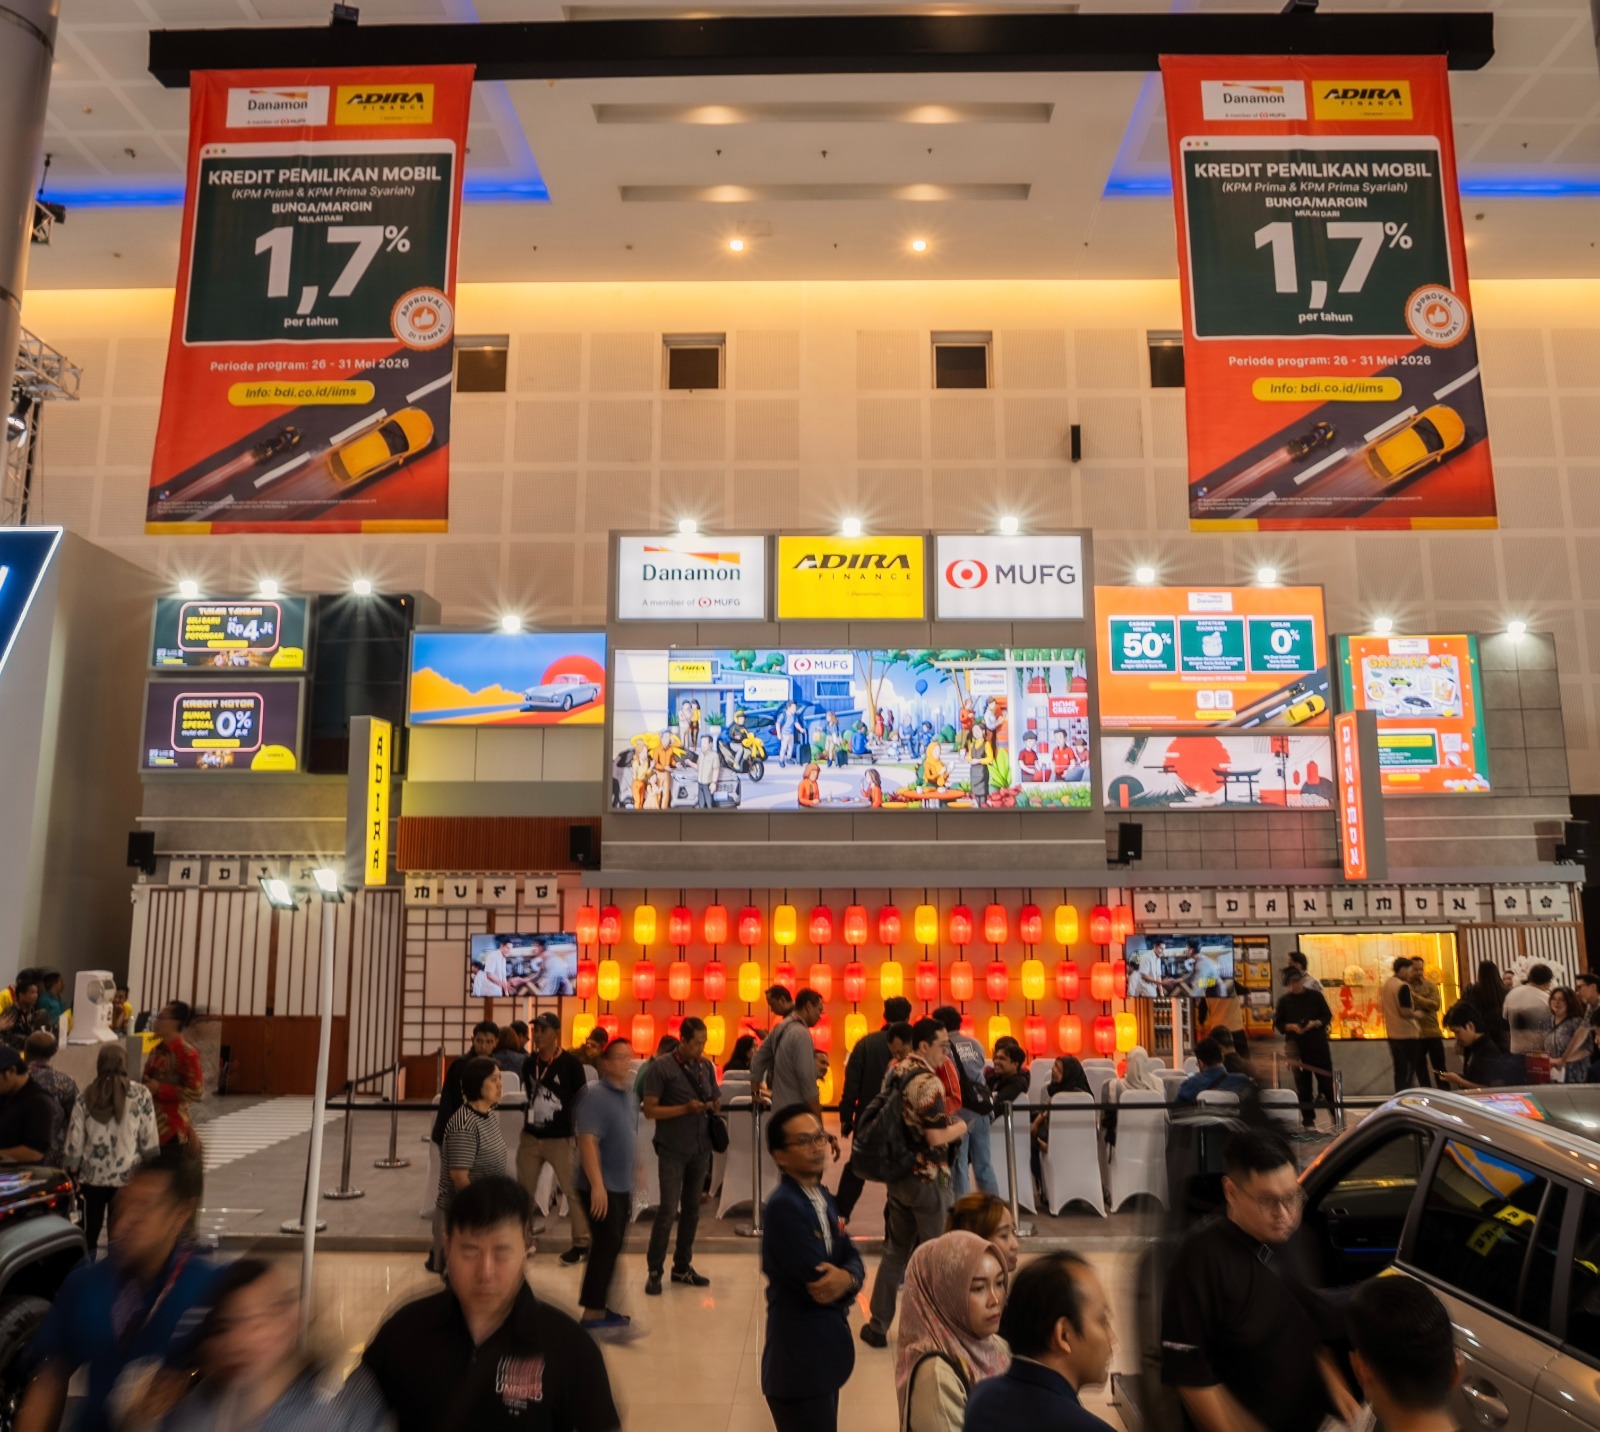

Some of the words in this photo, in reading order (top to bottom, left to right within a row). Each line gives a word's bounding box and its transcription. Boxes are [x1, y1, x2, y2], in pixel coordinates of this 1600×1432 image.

[347, 92, 424, 104] ADIRA
[1223, 92, 1285, 104] Danamon
[1323, 88, 1402, 99] ADIRA
[248, 99, 308, 111] Danamon
[208, 169, 275, 186] KREDIT
[279, 167, 379, 183] PEMILIKAN
[382, 166, 442, 181] MOBIL
[1194, 163, 1262, 178] KREDIT
[1267, 162, 1369, 178] PEMILIKAN
[1372, 162, 1432, 177] MOBIL
[232, 187, 261, 200] (KPM
[263, 187, 294, 198] Prima
[296, 187, 305, 197] &
[307, 187, 333, 197] KPM
[335, 186, 367, 197] Prima
[369, 185, 416, 199] Syariah)
[1222, 181, 1252, 193] (KPM
[1254, 182, 1287, 192] Prima
[1289, 182, 1297, 192] &
[1300, 182, 1325, 192] KPM
[1327, 182, 1360, 192] Prima
[1362, 181, 1408, 194] Syariah)
[272, 201, 372, 214] BUNGA/MARGIN
[1265, 197, 1368, 208] BUNGA/MARGIN
[298, 215, 323, 223] MULAI
[324, 215, 343, 223] DARI
[1295, 210, 1320, 218] MULAI
[1321, 210, 1340, 218] DARI
[254, 225, 411, 315] 1,7%
[1254, 221, 1413, 310] 1,7%
[401, 295, 443, 318] APPROVAL
[1414, 292, 1453, 314] APPROVAL
[284, 317, 304, 329] per
[306, 316, 339, 327] tahun
[1298, 314, 1318, 324] per
[1320, 312, 1353, 323] tahun
[408, 331, 416, 339] DI
[417, 323, 447, 342] TEMPAT
[1425, 328, 1434, 337] DI
[1435, 320, 1460, 339] TEMPAT
[210, 362, 254, 372] Periode
[257, 360, 309, 373] program:
[311, 360, 326, 370] 26
[338, 359, 351, 369] 31
[354, 358, 376, 369] Mei
[378, 358, 410, 369] 2026
[1228, 355, 1274, 366] Periode
[1277, 356, 1330, 368] program:
[1333, 355, 1348, 366] 26
[1360, 355, 1374, 365] 31
[1376, 355, 1398, 366] Mei
[1401, 355, 1431, 366] 2026
[246, 385, 271, 398] Info:
[274, 385, 357, 399] bdi.co.id/iims
[1270, 383, 1297, 395] Info:
[1301, 383, 1384, 395] bdi.co.id/iims
[793, 554, 910, 569] ADIRA
[642, 564, 741, 581] Danamon
[995, 564, 1076, 585] MUFG
[686, 598, 695, 606] of
[1123, 632, 1172, 659] 50%
[1270, 628, 1301, 655] 0%
[814, 661, 848, 669] MUFG
[974, 678, 1005, 686] Danamon
[182, 699, 218, 709] KREDIT
[220, 699, 254, 709] MOTOR
[1052, 706, 1079, 714] CREDIT
[182, 711, 211, 720] BUNGA
[182, 720, 214, 730] SPESIAL
[216, 711, 253, 738] 0%
[1342, 725, 1360, 866] DANAMON
[373, 735, 383, 870] ADIRA
